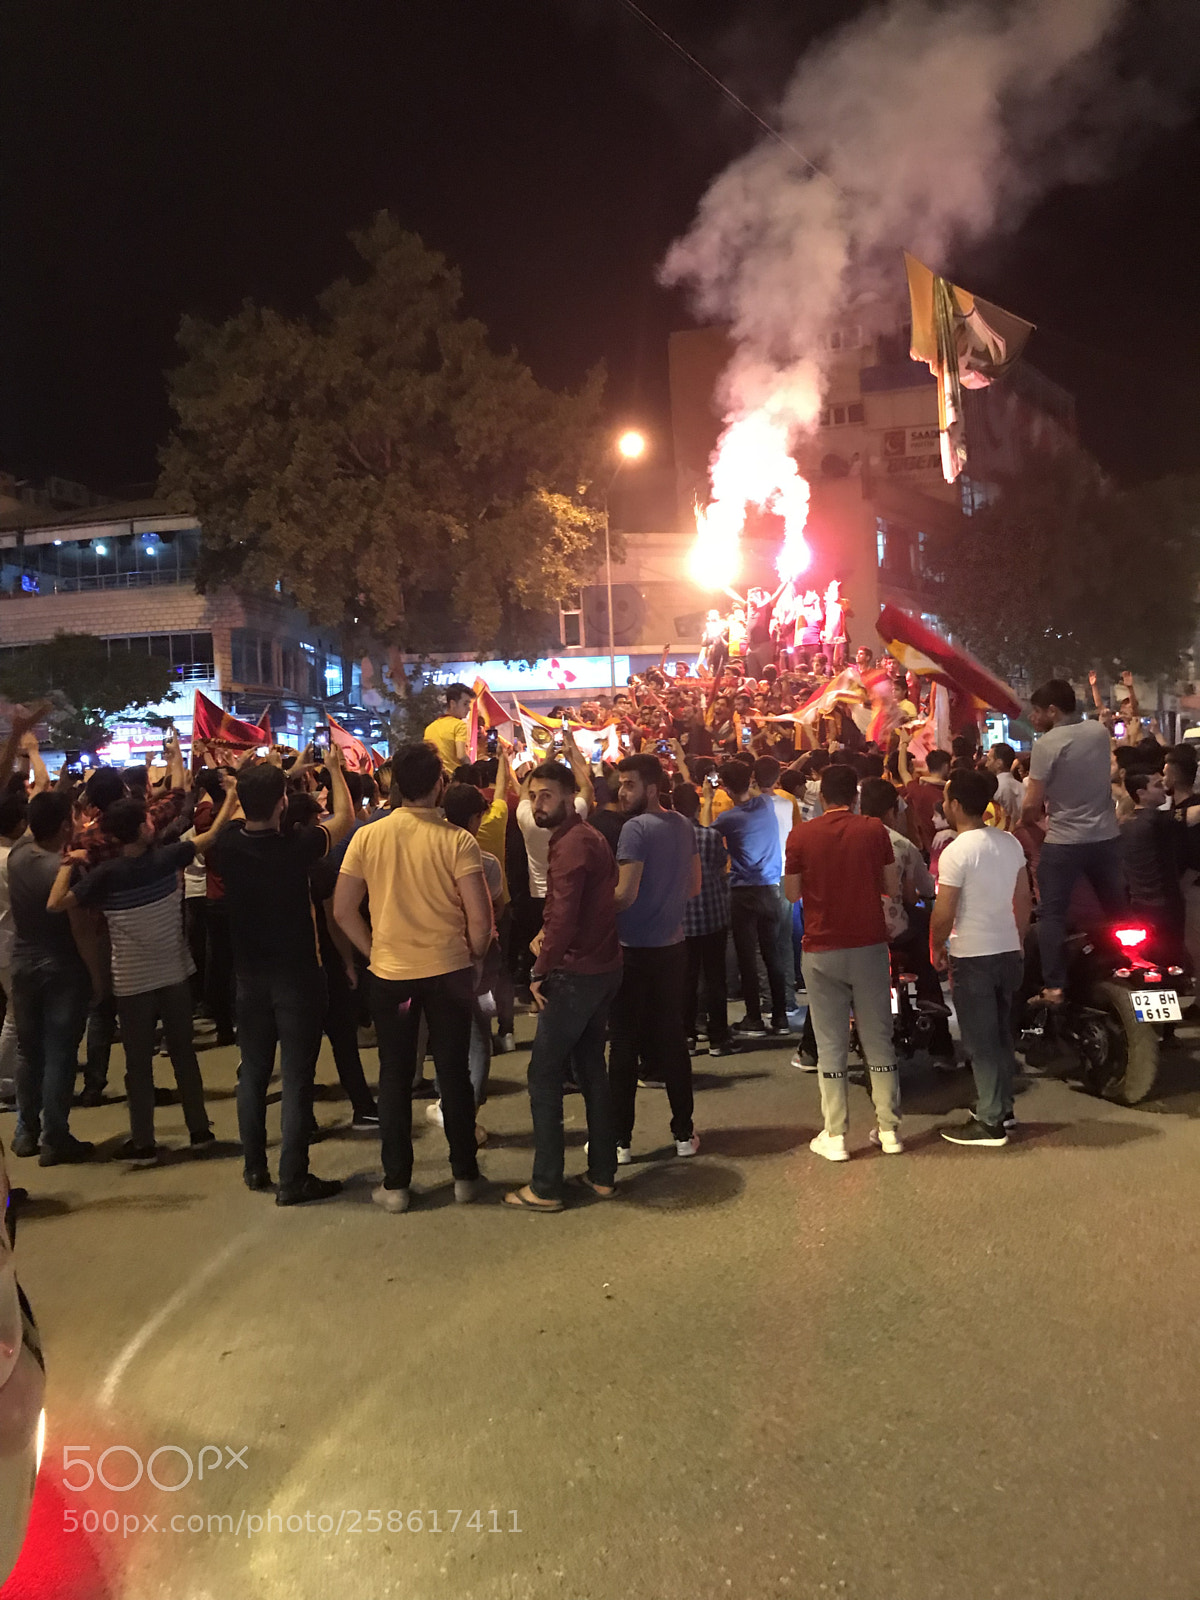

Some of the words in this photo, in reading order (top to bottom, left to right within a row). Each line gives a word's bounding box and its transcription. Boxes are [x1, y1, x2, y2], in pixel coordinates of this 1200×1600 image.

[1135, 995, 1151, 1006] 02
[1159, 993, 1176, 1005] BH
[1146, 1007, 1171, 1020] 615
